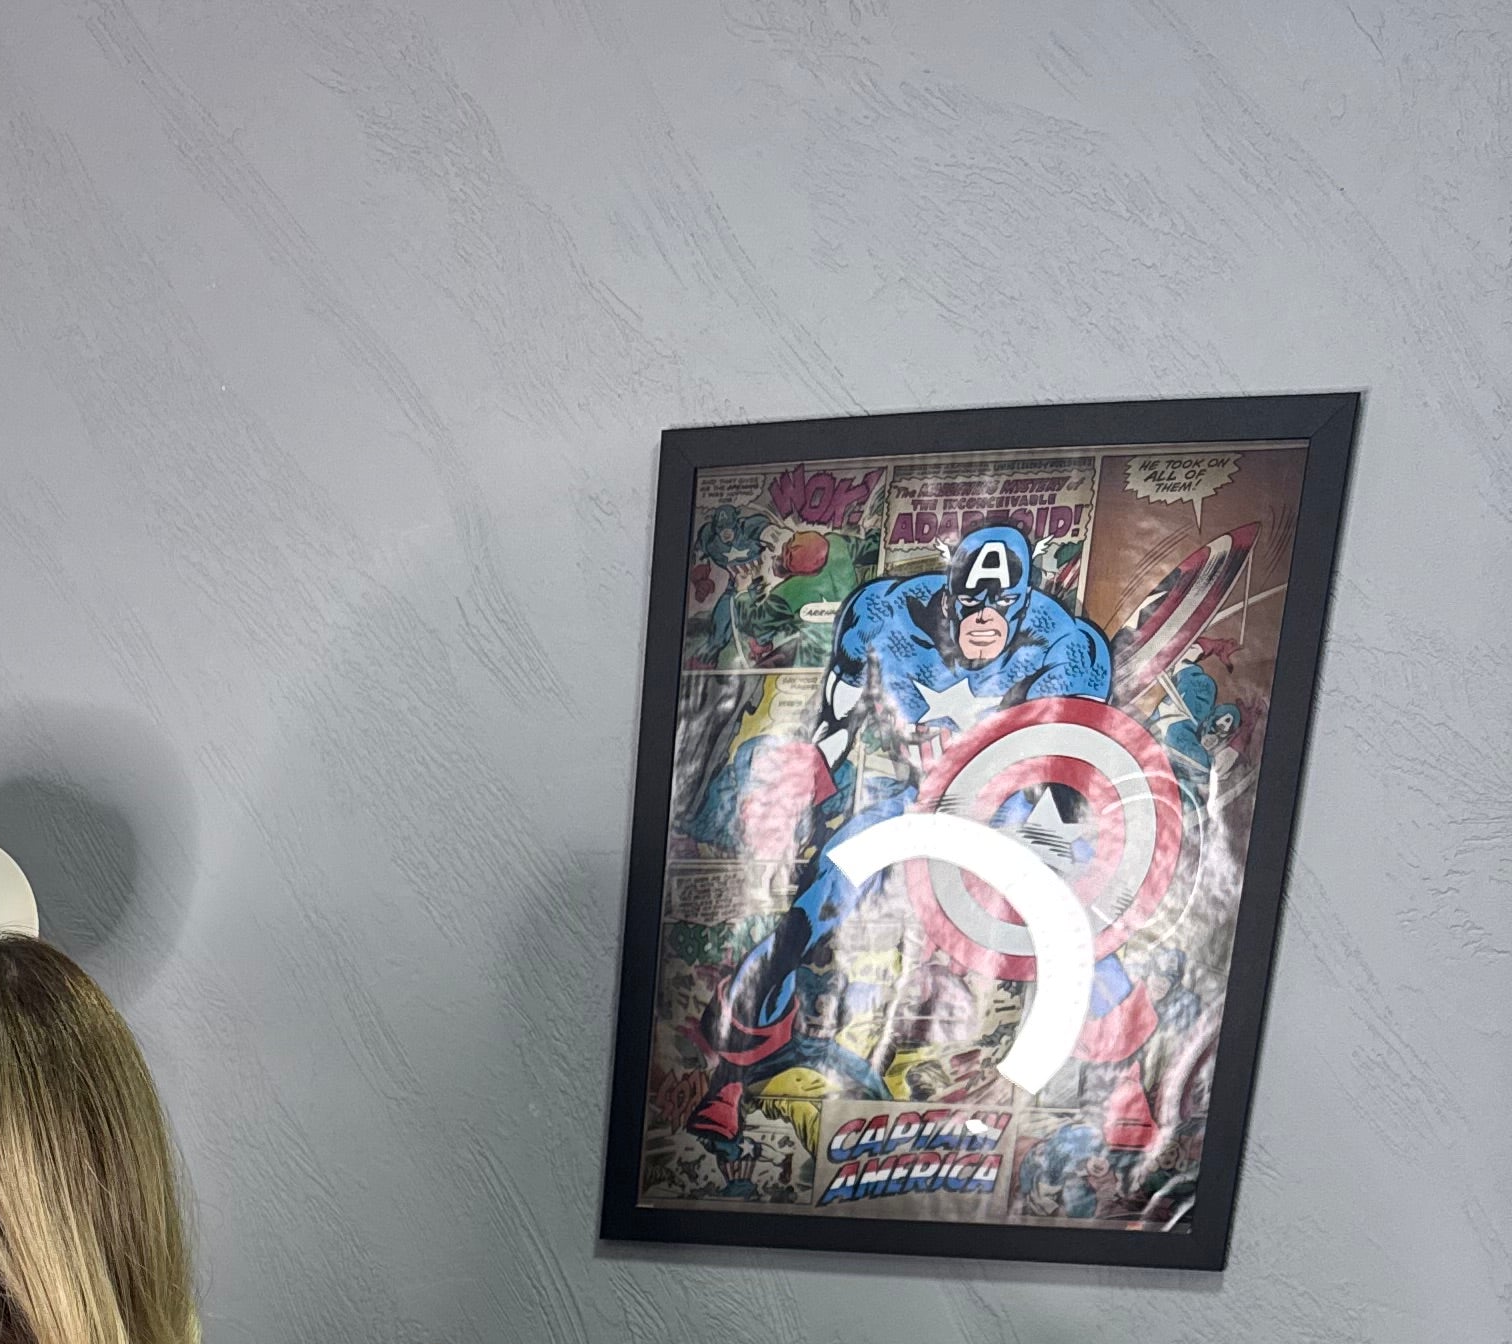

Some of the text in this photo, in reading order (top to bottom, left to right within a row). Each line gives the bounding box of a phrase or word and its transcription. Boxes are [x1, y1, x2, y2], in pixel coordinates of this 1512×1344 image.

[1138, 458, 1230, 471] HE TOOK ON
[1144, 469, 1207, 482] ALL OF
[1000, 475, 1073, 495] MYSTERY
[1155, 479, 1202, 493] THEM!
[826, 1109, 1013, 1163] CAPTAIN
[814, 1151, 1003, 1208] AMERICA
